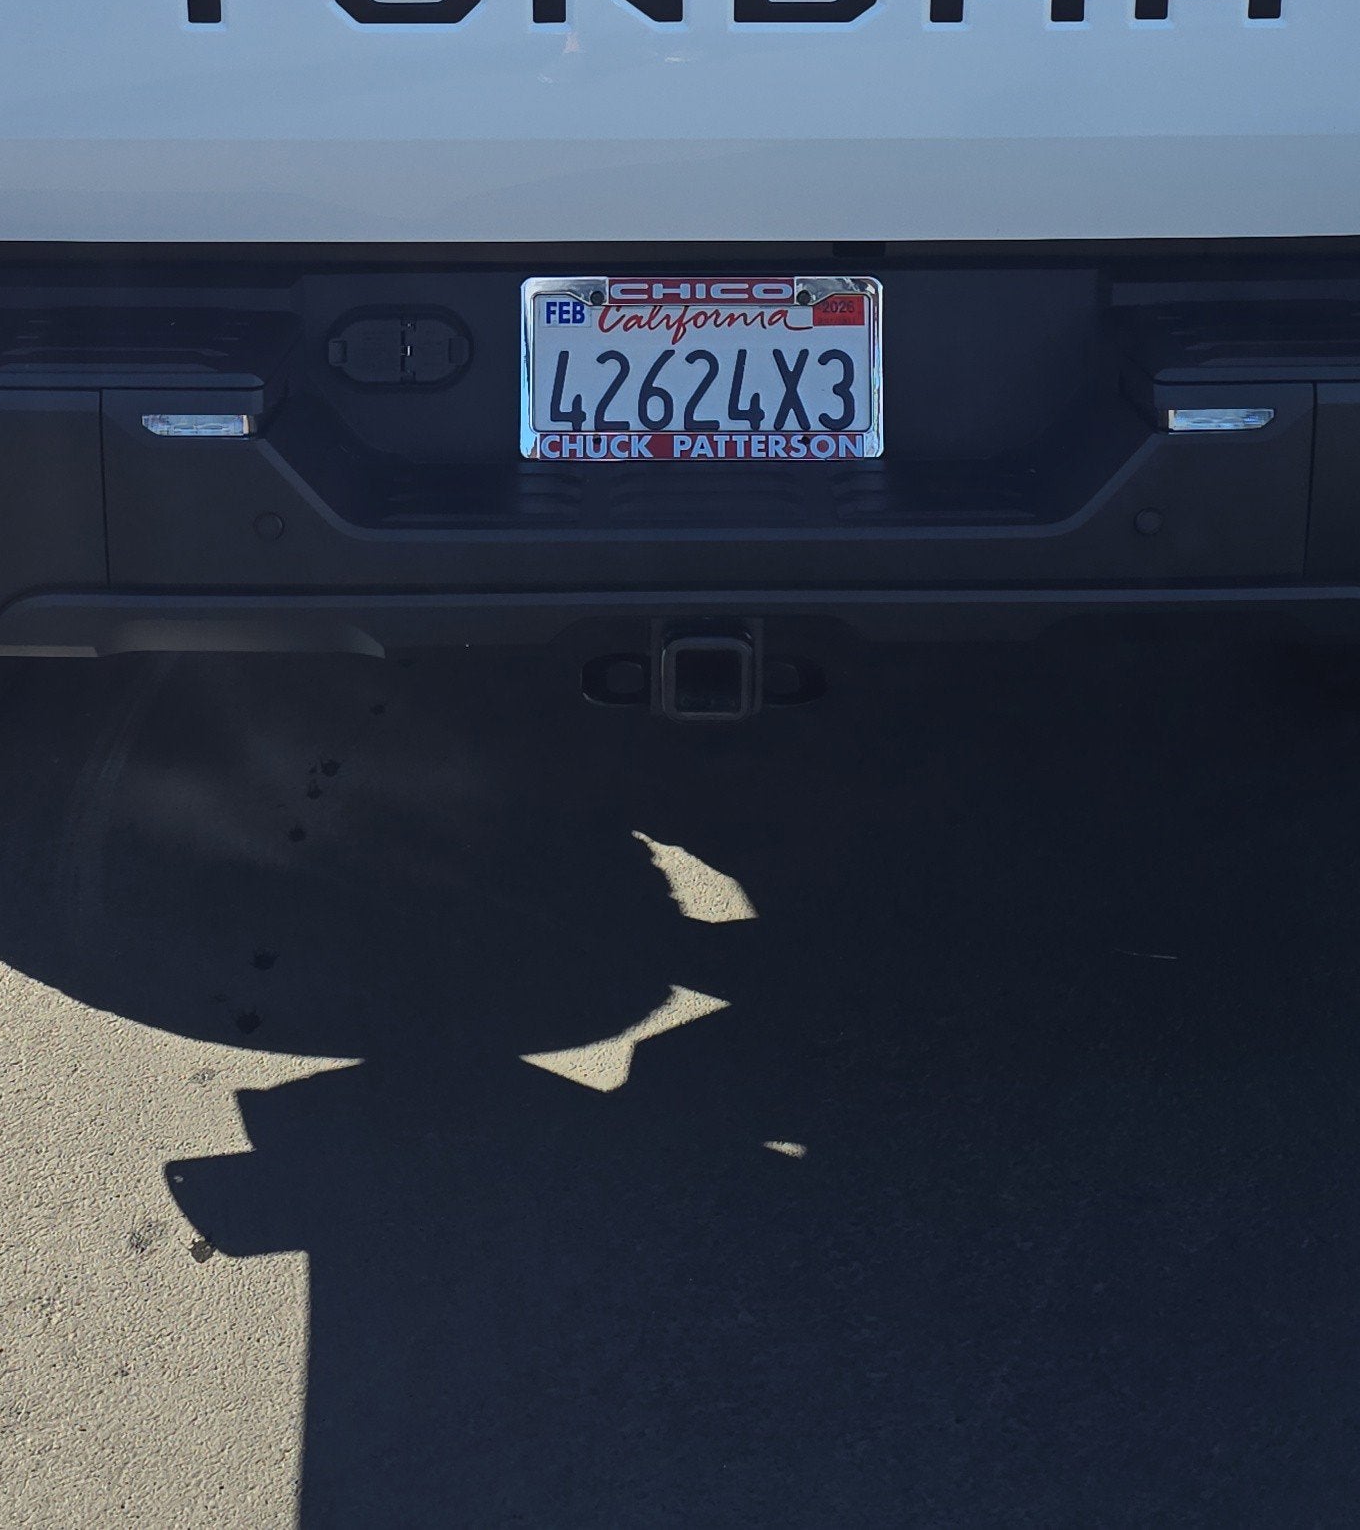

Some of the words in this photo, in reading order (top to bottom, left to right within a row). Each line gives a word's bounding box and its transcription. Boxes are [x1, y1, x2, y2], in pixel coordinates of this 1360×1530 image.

[610, 282, 793, 299] CHICO
[545, 301, 585, 324] FEB
[822, 300, 855, 313] 2026
[598, 305, 813, 345] California
[549, 348, 856, 431] 42624X3
[540, 434, 653, 458] CHUCK
[673, 434, 865, 458] PATTERSON
